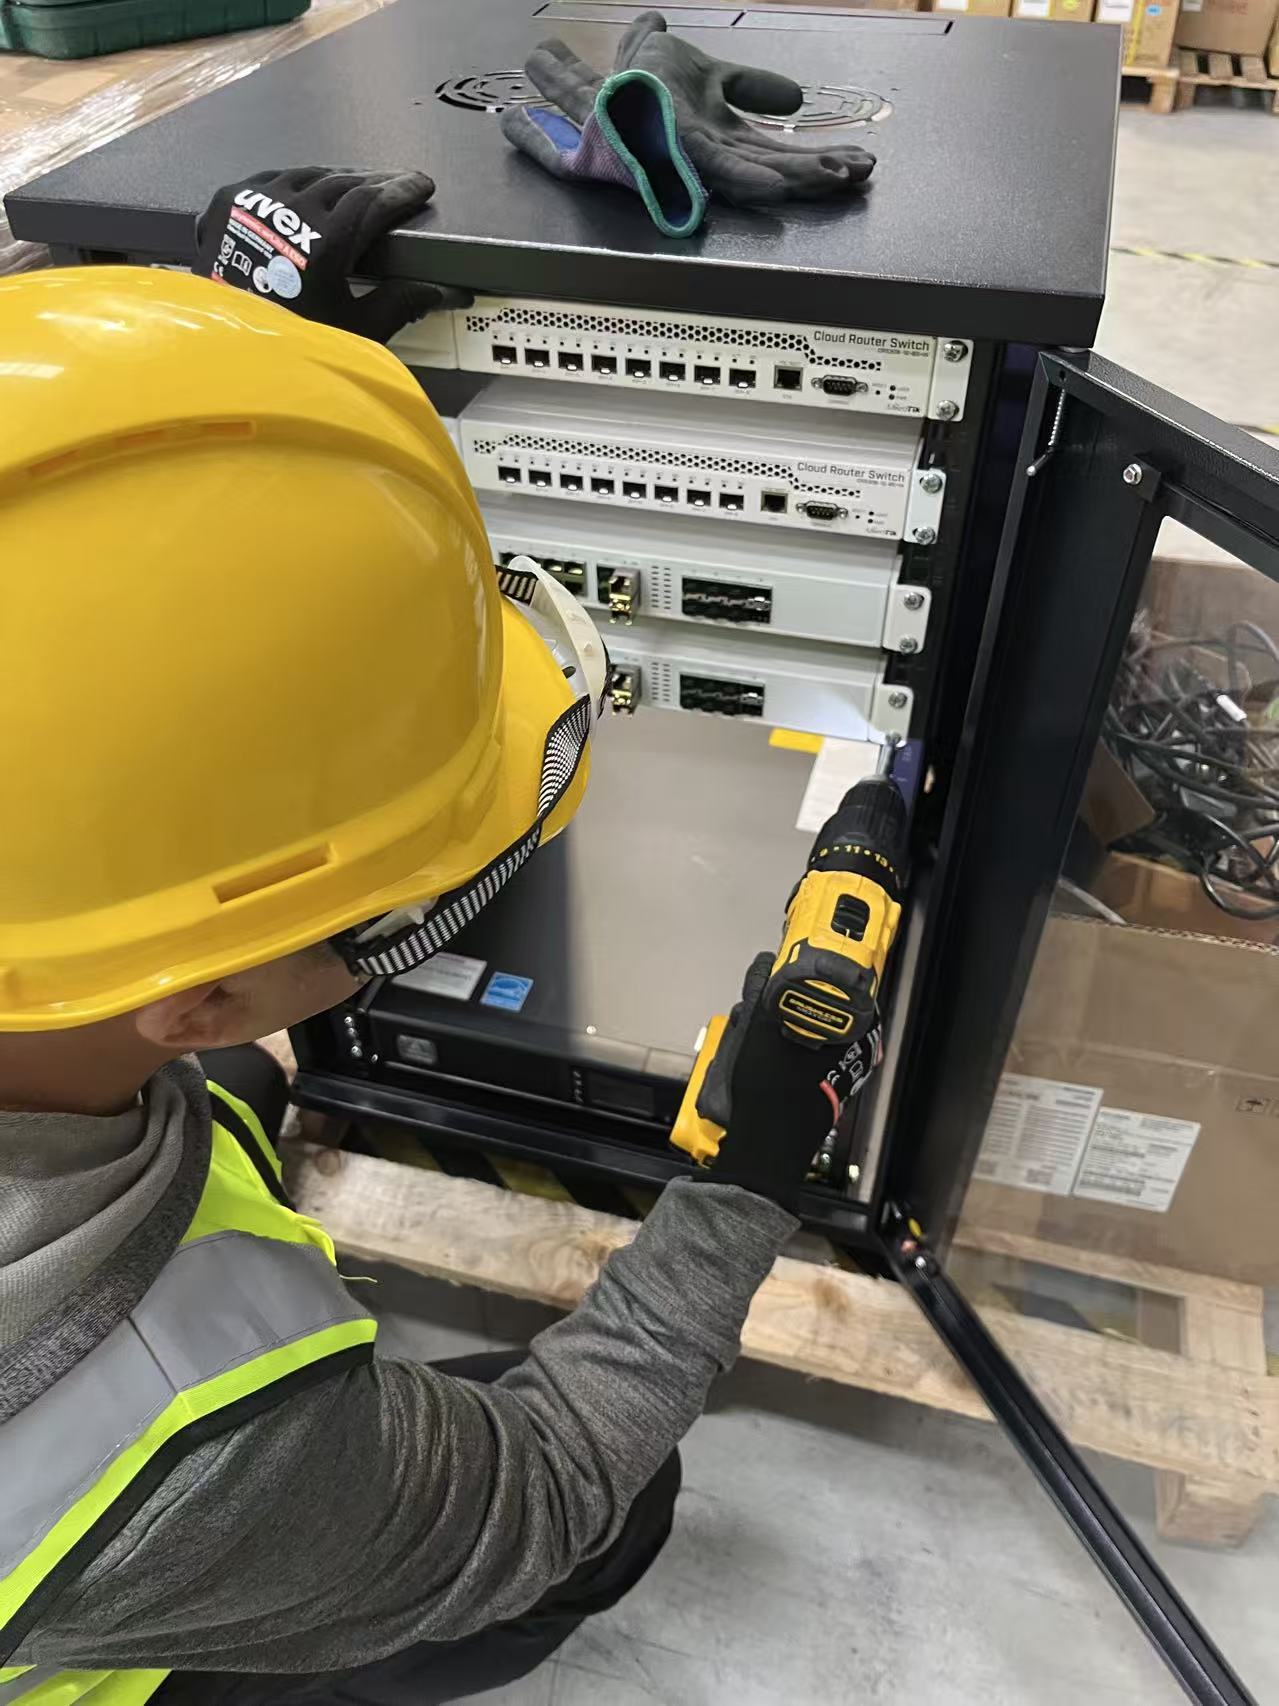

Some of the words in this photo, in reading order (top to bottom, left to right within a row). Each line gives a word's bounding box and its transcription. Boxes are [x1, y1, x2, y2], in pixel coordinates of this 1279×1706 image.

[234, 189, 322, 254] uvex
[814, 331, 846, 343] Cloud
[849, 334, 887, 347] Router
[890, 338, 929, 351] Switch
[797, 462, 827, 474] Cloud
[830, 466, 865, 478] Router
[868, 470, 904, 482] Switch
[845, 845, 860, 854] 11
